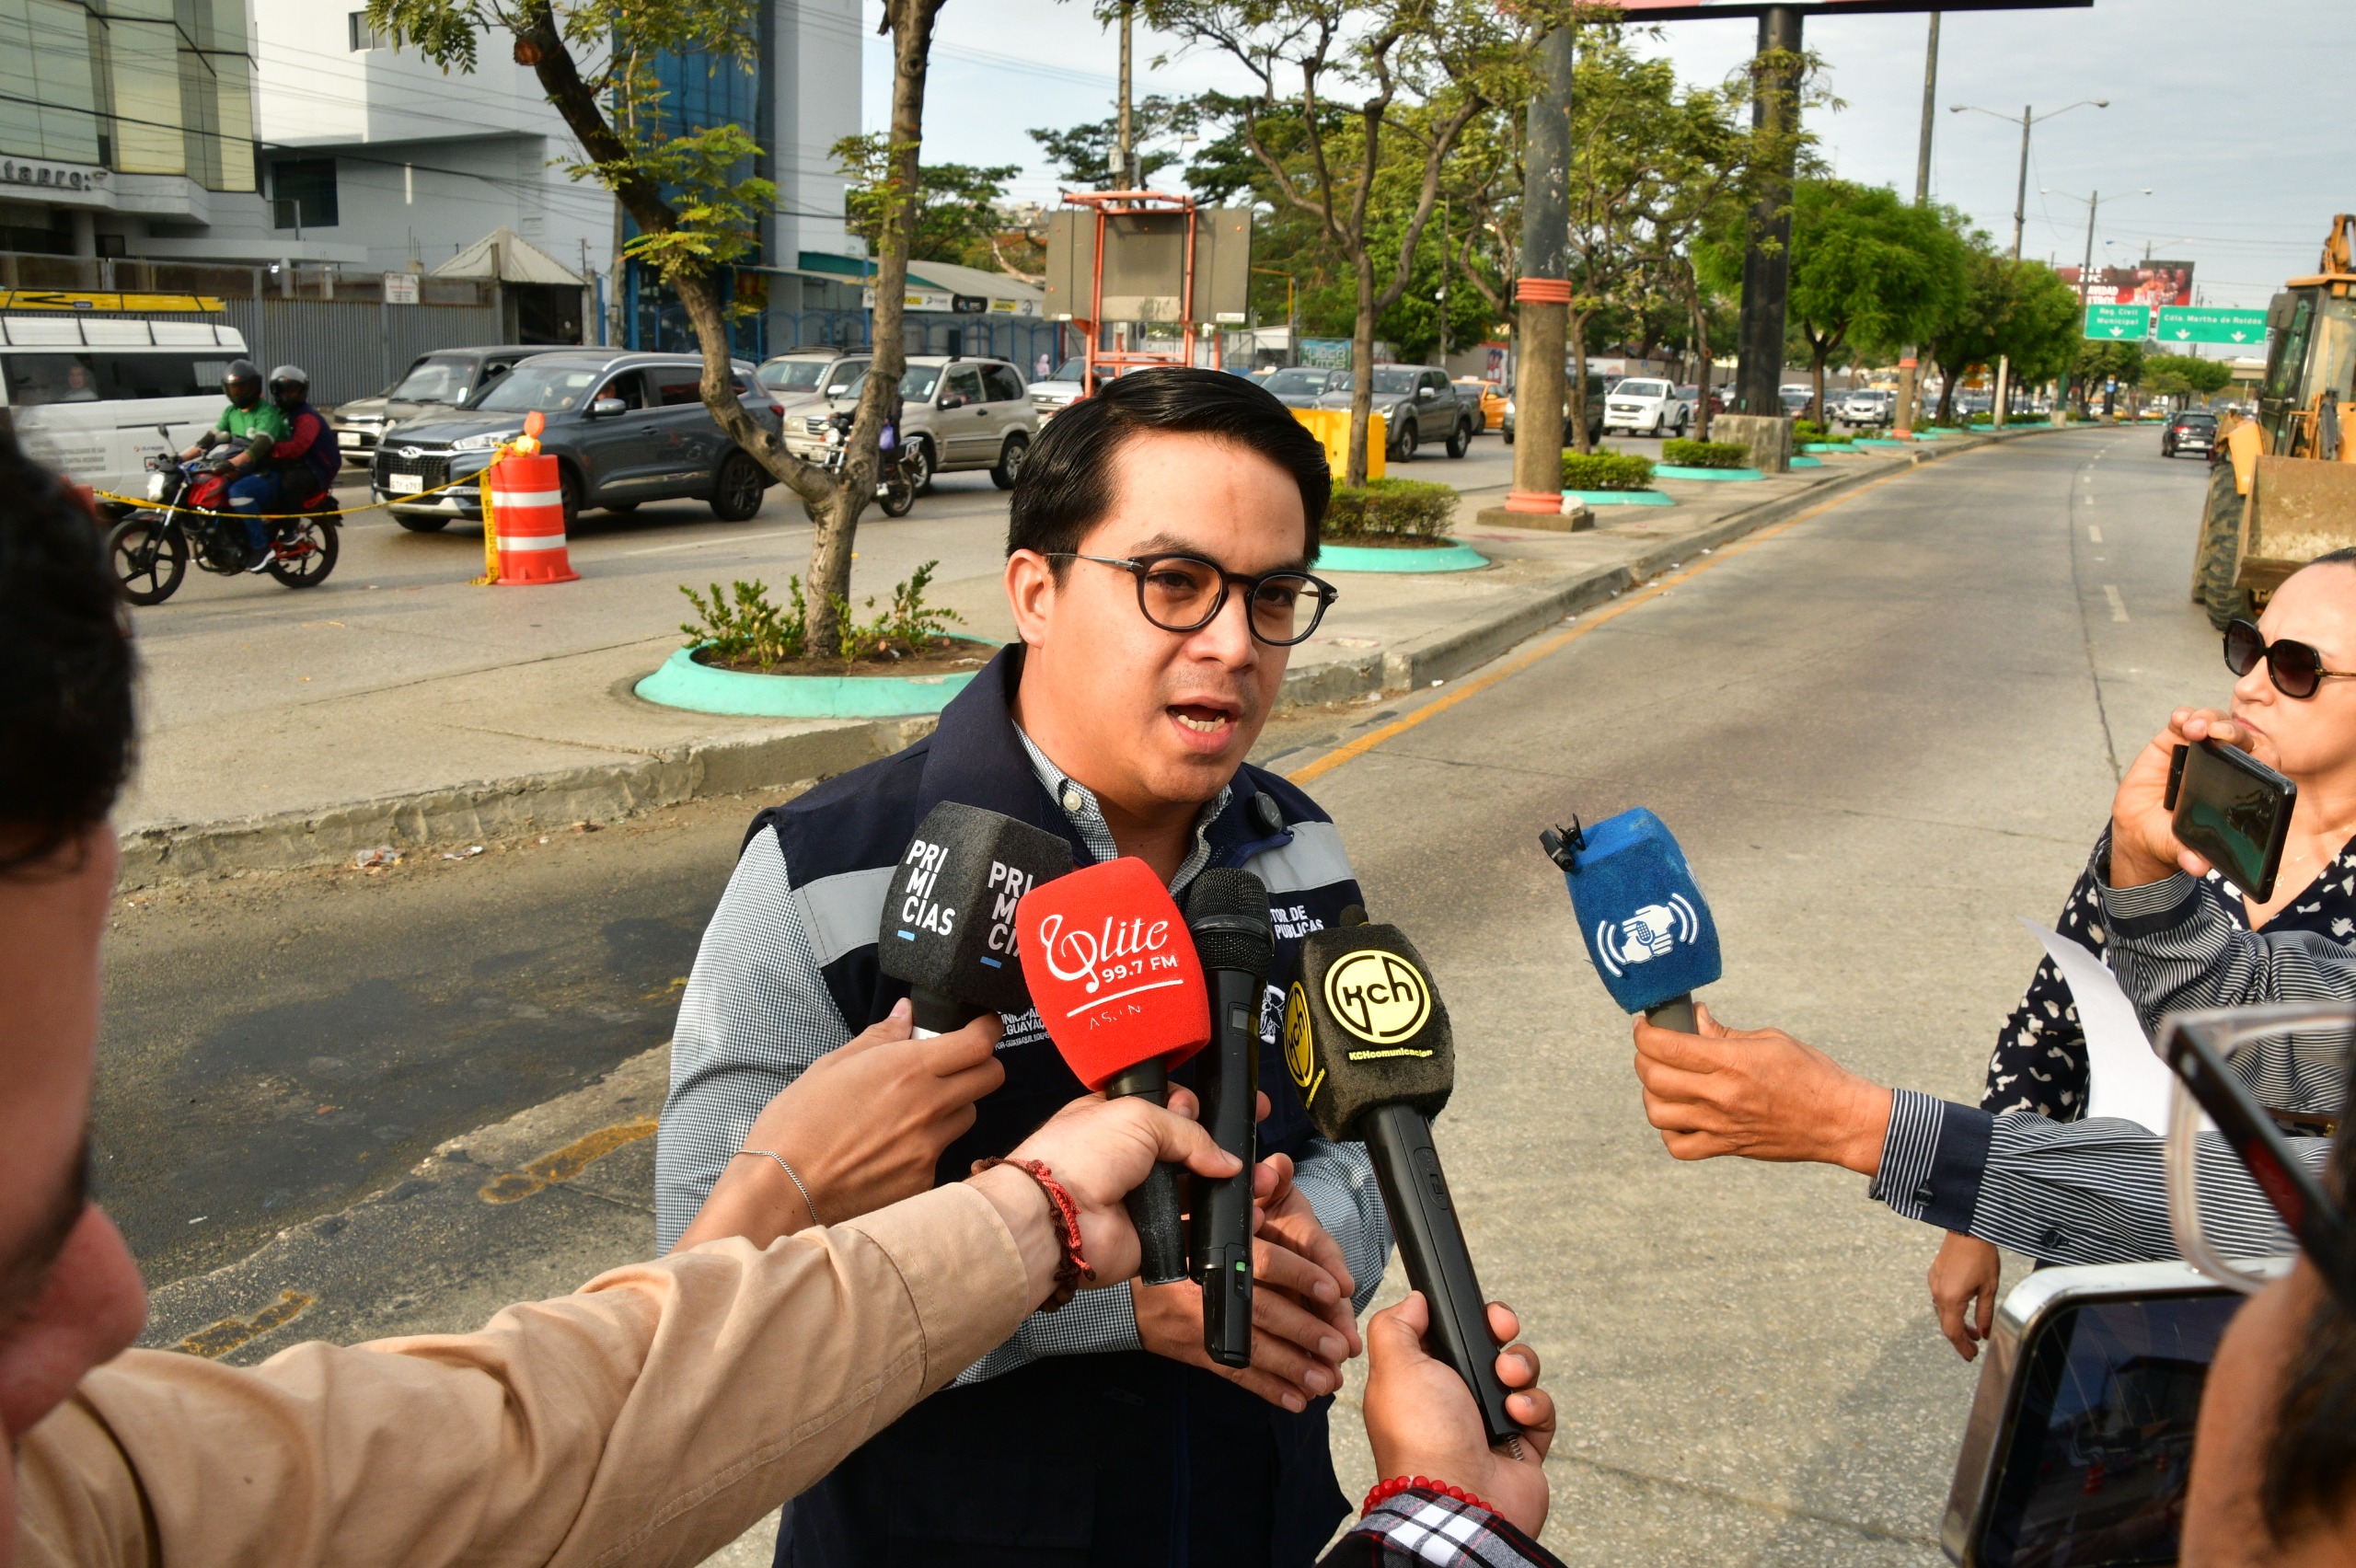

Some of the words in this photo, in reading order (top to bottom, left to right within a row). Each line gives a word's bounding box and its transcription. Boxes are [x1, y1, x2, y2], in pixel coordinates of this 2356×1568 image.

[2096, 317, 2140, 327] Municipal
[906, 839, 949, 873] PRI
[906, 868, 937, 900] MI
[987, 860, 1034, 899] PRI
[902, 895, 956, 936] CIAS
[991, 893, 1018, 926] M
[1289, 905, 1308, 922] DE
[987, 923, 1020, 958] CI
[1102, 960, 1143, 983] 99.7
[1150, 954, 1178, 971] FM
